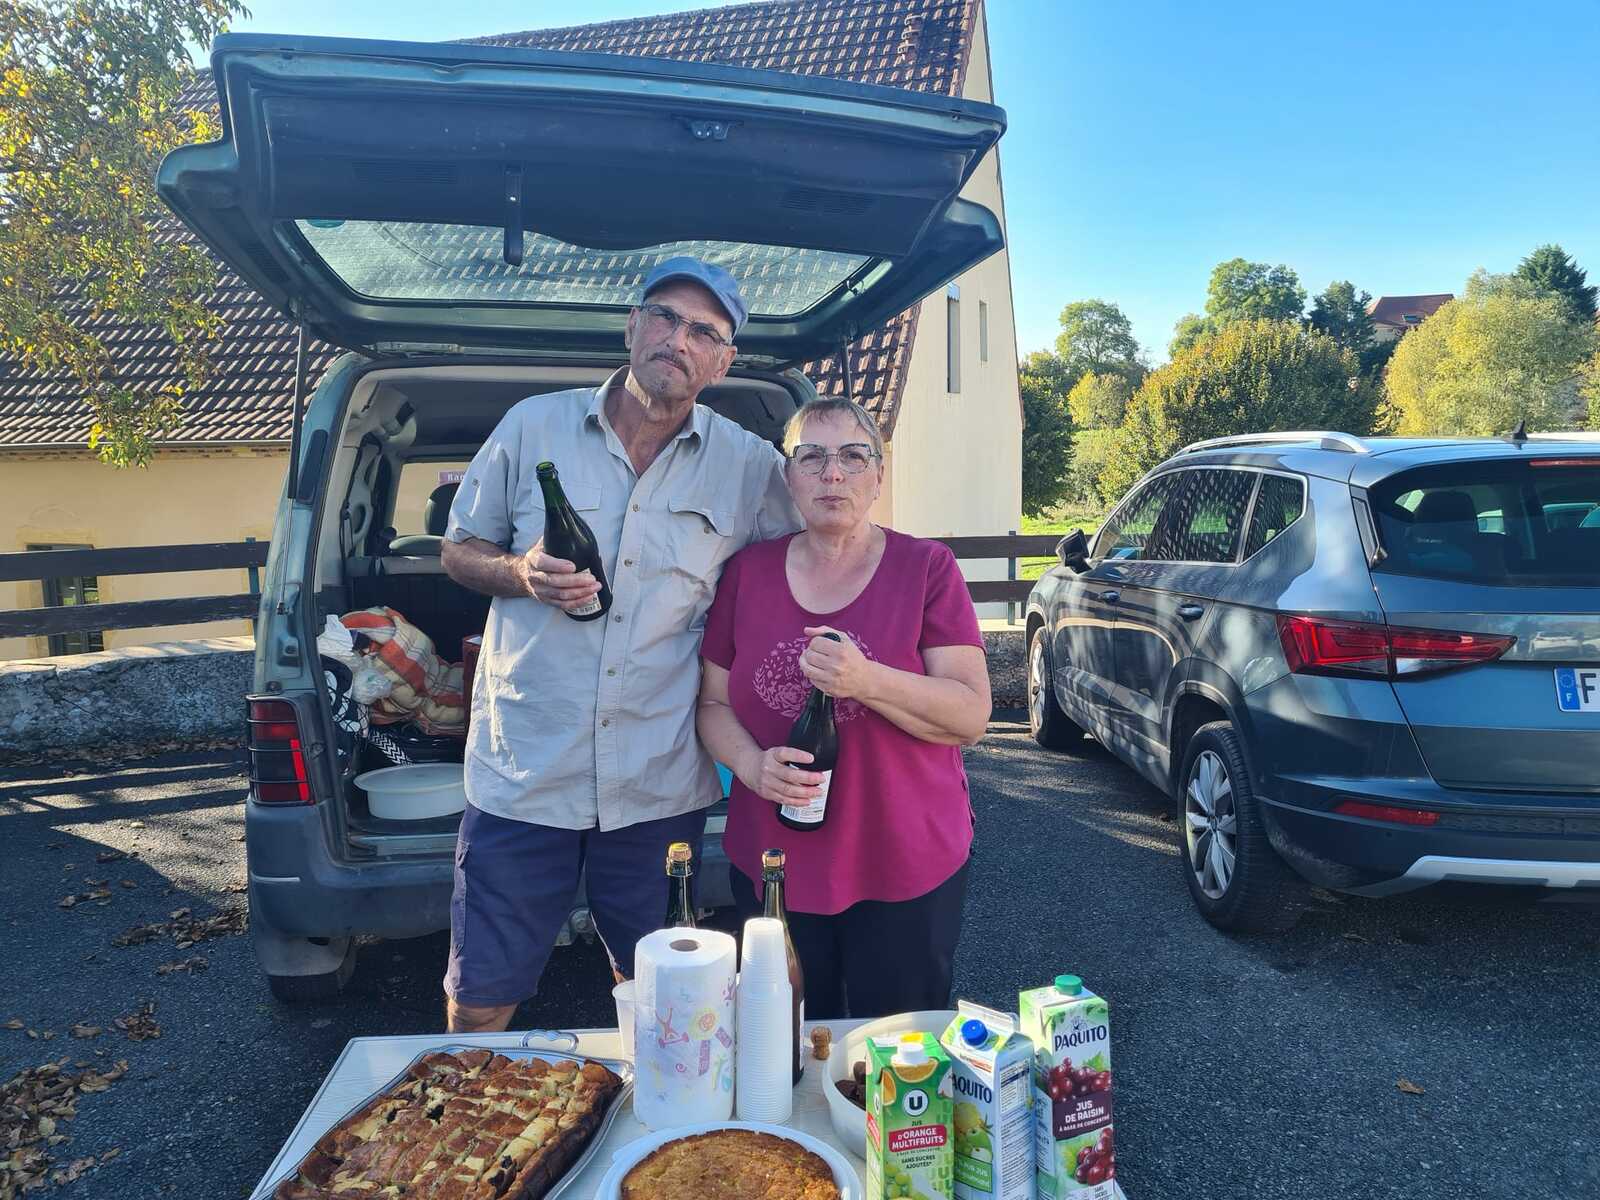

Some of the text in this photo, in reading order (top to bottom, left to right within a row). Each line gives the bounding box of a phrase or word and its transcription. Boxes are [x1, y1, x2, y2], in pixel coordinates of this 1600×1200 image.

[1580, 672, 1597, 704] F
[1054, 1024, 1107, 1052] PAQUITO
[951, 1072, 993, 1104] AQUITO
[908, 1095, 923, 1110] U
[1075, 1100, 1093, 1112] JUS
[1065, 1106, 1105, 1124] DE RAISIN
[891, 1135, 944, 1150] MULTIFRUITS
